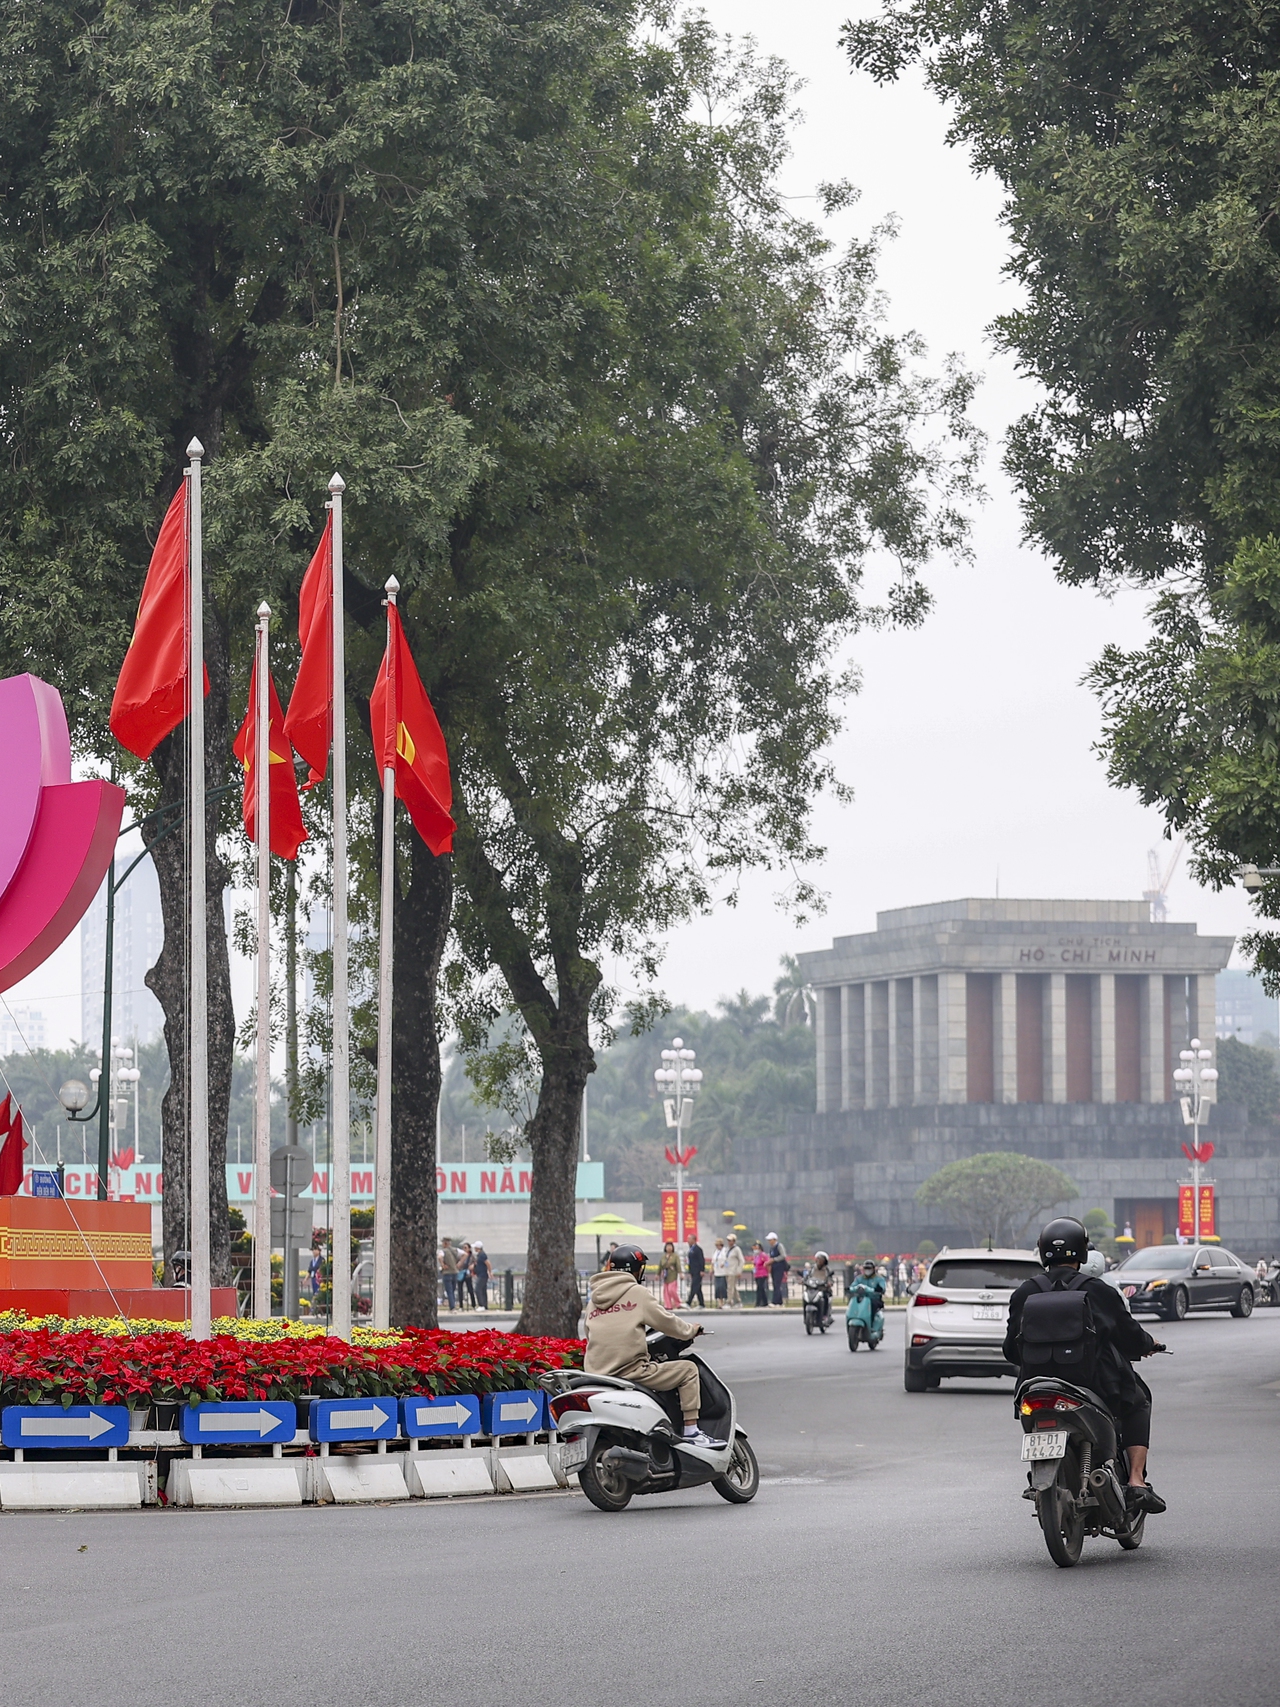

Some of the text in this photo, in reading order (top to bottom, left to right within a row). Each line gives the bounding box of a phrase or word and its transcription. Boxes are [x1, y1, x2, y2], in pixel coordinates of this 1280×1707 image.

[311, 1171, 373, 1195] NM
[1030, 1434, 1059, 1447] 81-D1
[1025, 1445, 1063, 1459] 144.22
